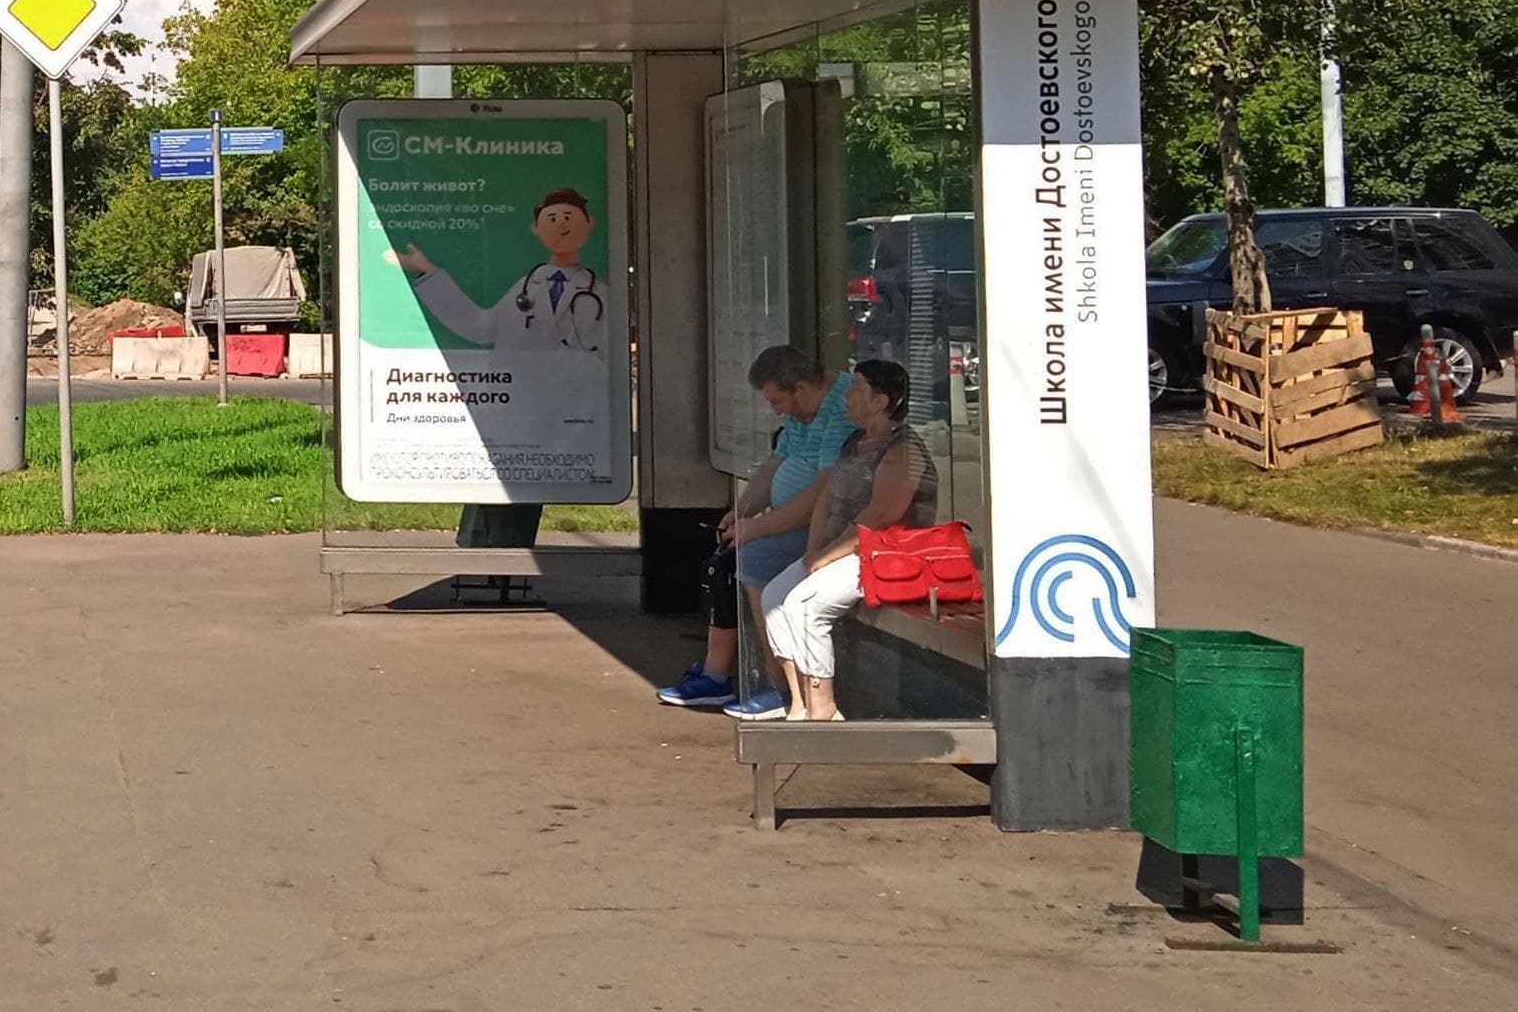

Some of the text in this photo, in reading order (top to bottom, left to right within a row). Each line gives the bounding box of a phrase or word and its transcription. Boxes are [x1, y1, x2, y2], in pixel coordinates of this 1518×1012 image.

[403, 135, 565, 156] СМ-Клиника
[1070, 0, 1098, 323] Shkola Imeni Dostoevskogo
[368, 178, 486, 192] Болит живот?
[1042, 217, 1064, 313] имени
[386, 368, 513, 386] Диагностика
[1039, 322, 1068, 425] Школа
[386, 391, 511, 406] для каждого
